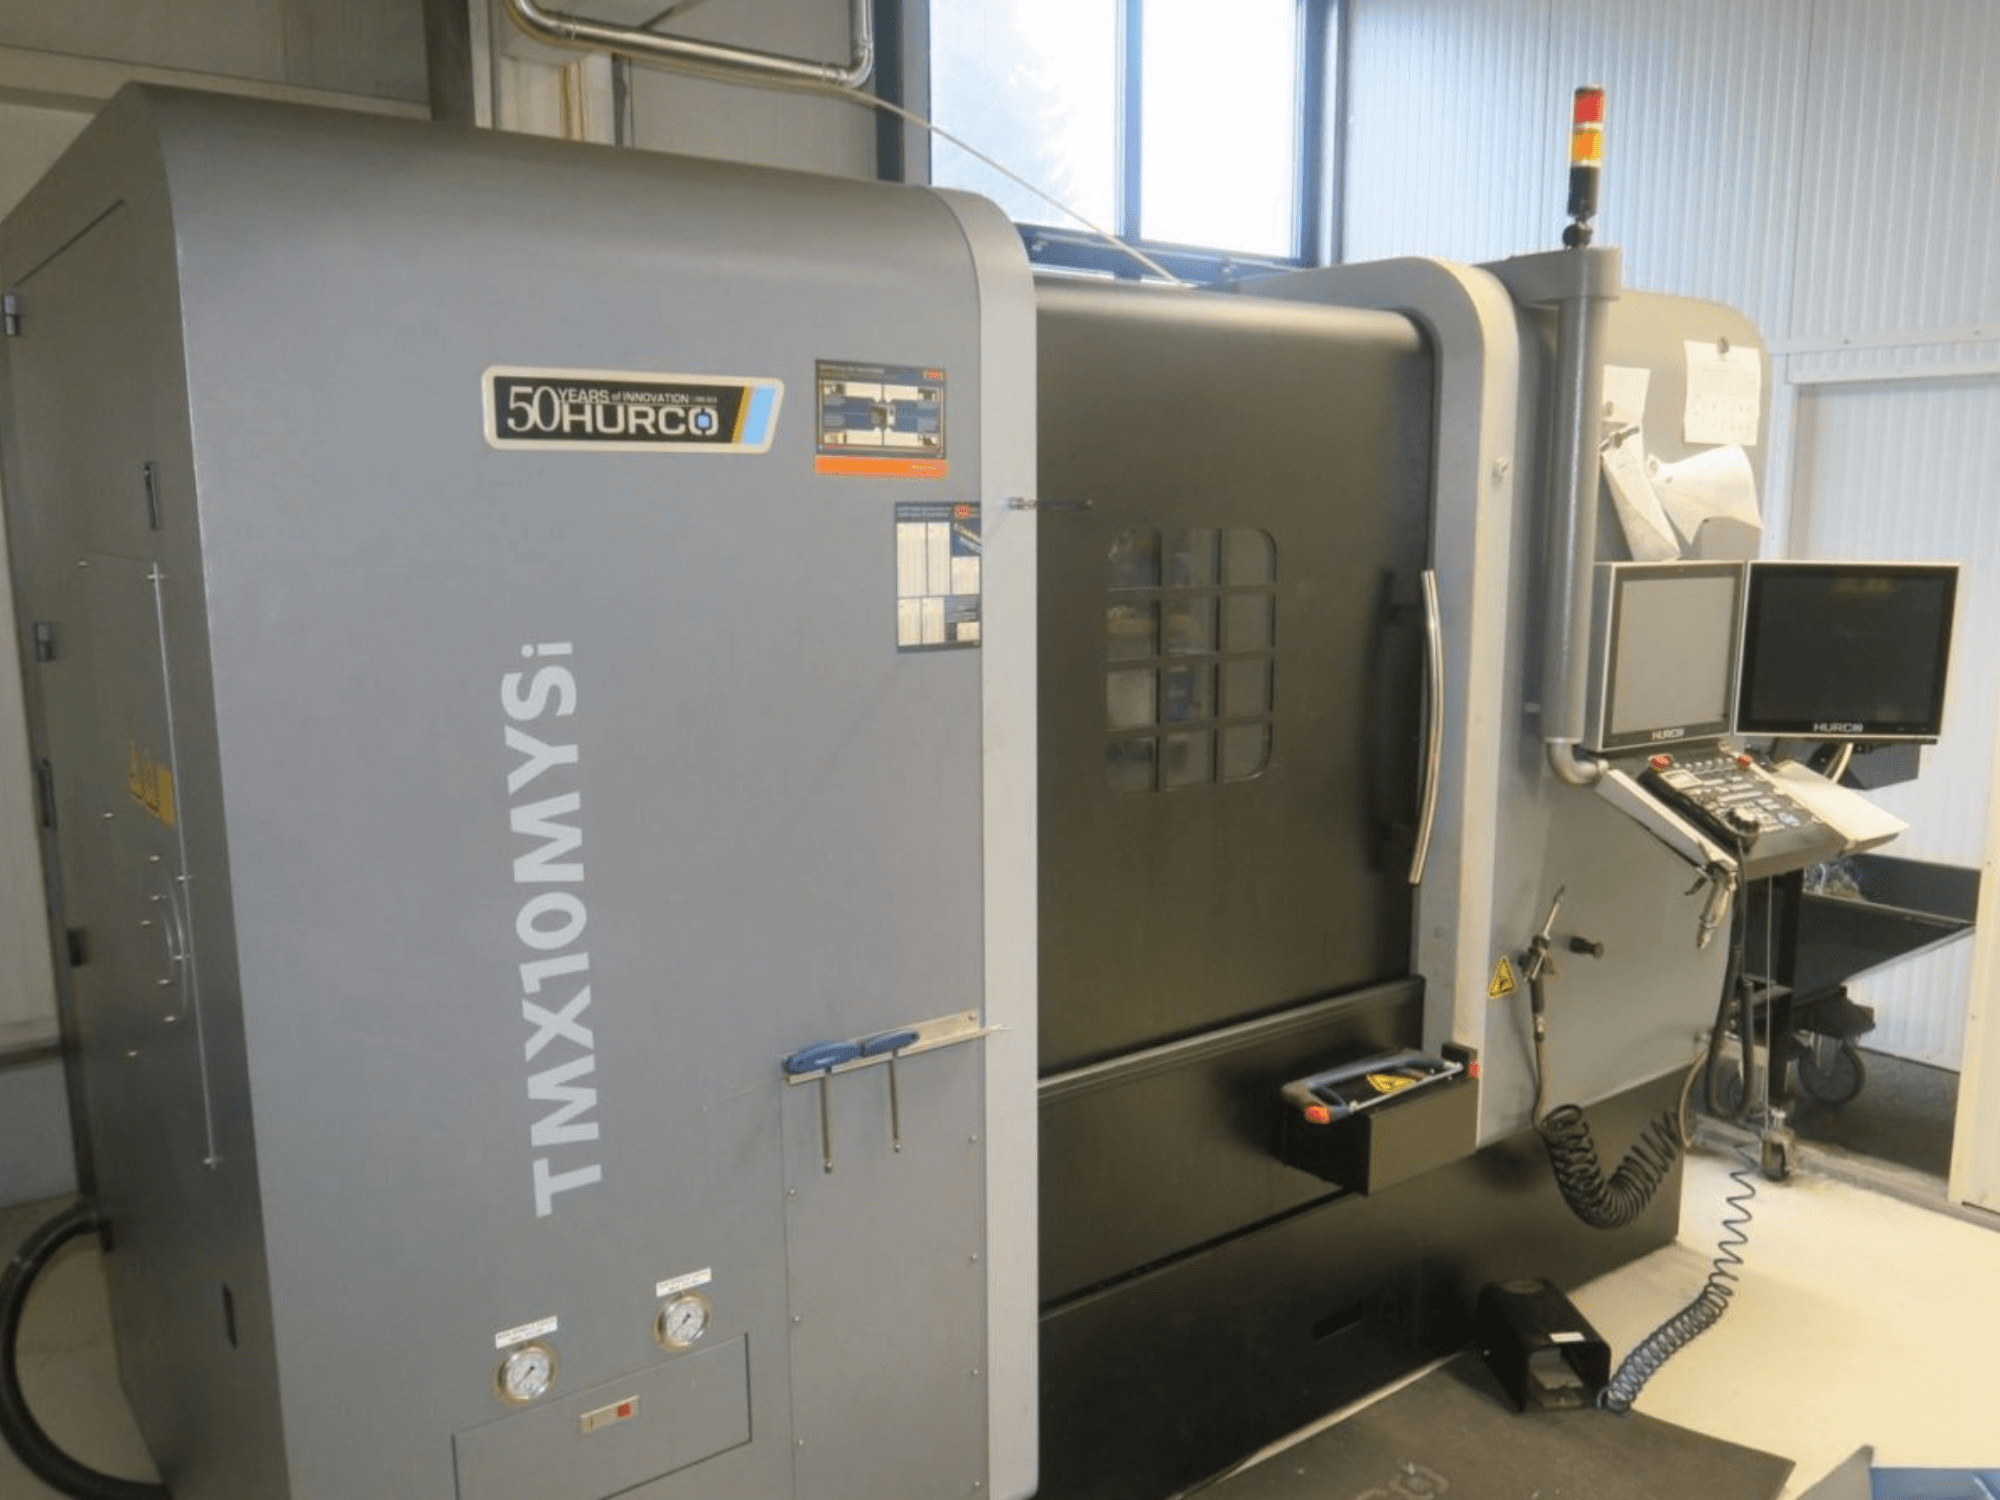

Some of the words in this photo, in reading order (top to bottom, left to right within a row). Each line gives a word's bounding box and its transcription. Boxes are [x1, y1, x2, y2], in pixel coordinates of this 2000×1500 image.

[507, 385, 560, 432] 50
[557, 387, 610, 404] YEARS
[623, 391, 689, 404] INNOVATION
[562, 403, 719, 435] HURCO
[501, 641, 602, 1218] TMX10MYSi
